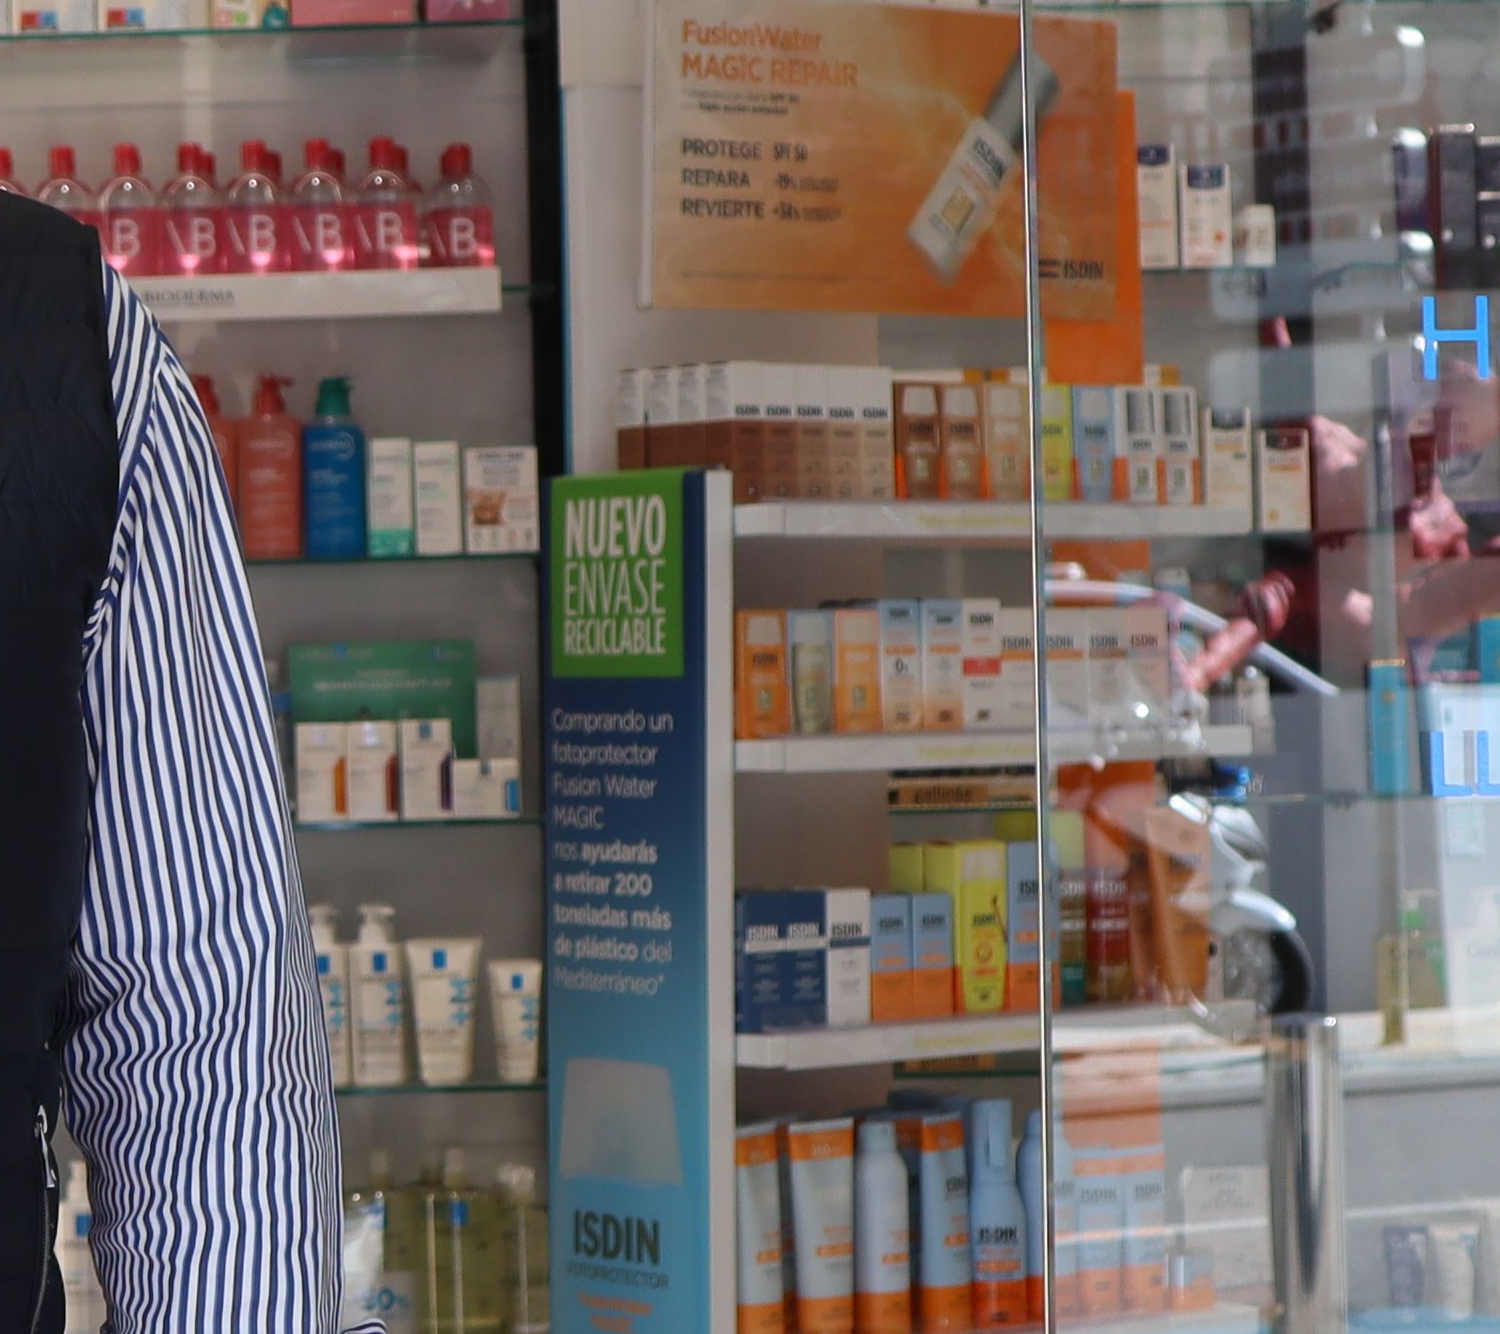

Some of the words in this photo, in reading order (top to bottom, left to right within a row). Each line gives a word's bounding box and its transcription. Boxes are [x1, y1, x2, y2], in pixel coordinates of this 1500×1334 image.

[680, 51, 763, 83] MAGIC
[771, 58, 859, 89] REPAIR
[681, 137, 763, 160] PROTEGE
[681, 167, 751, 187] REPARA
[680, 197, 765, 219] REVIERTE
[565, 494, 667, 558] NUEVO
[565, 557, 667, 617] ENVASE
[564, 615, 667, 656] RECICLABLE
[552, 706, 646, 735] Comprando
[650, 713, 674, 732] un
[552, 739, 659, 767] fotoprotector
[553, 771, 601, 797] Fusion
[604, 775, 658, 799] Water
[553, 803, 605, 831] MAGIC
[554, 842, 579, 862] nos
[581, 838, 658, 865] ayudarás
[565, 871, 610, 896] retirar
[614, 871, 653, 896] 200
[553, 903, 628, 929] toneladas
[631, 905, 672, 930] más
[831, 923, 863, 938] ISDIN
[555, 937, 572, 958] de
[574, 937, 640, 967] plástico
[641, 938, 673, 964] del
[572, 1209, 661, 1267] ISDIN
